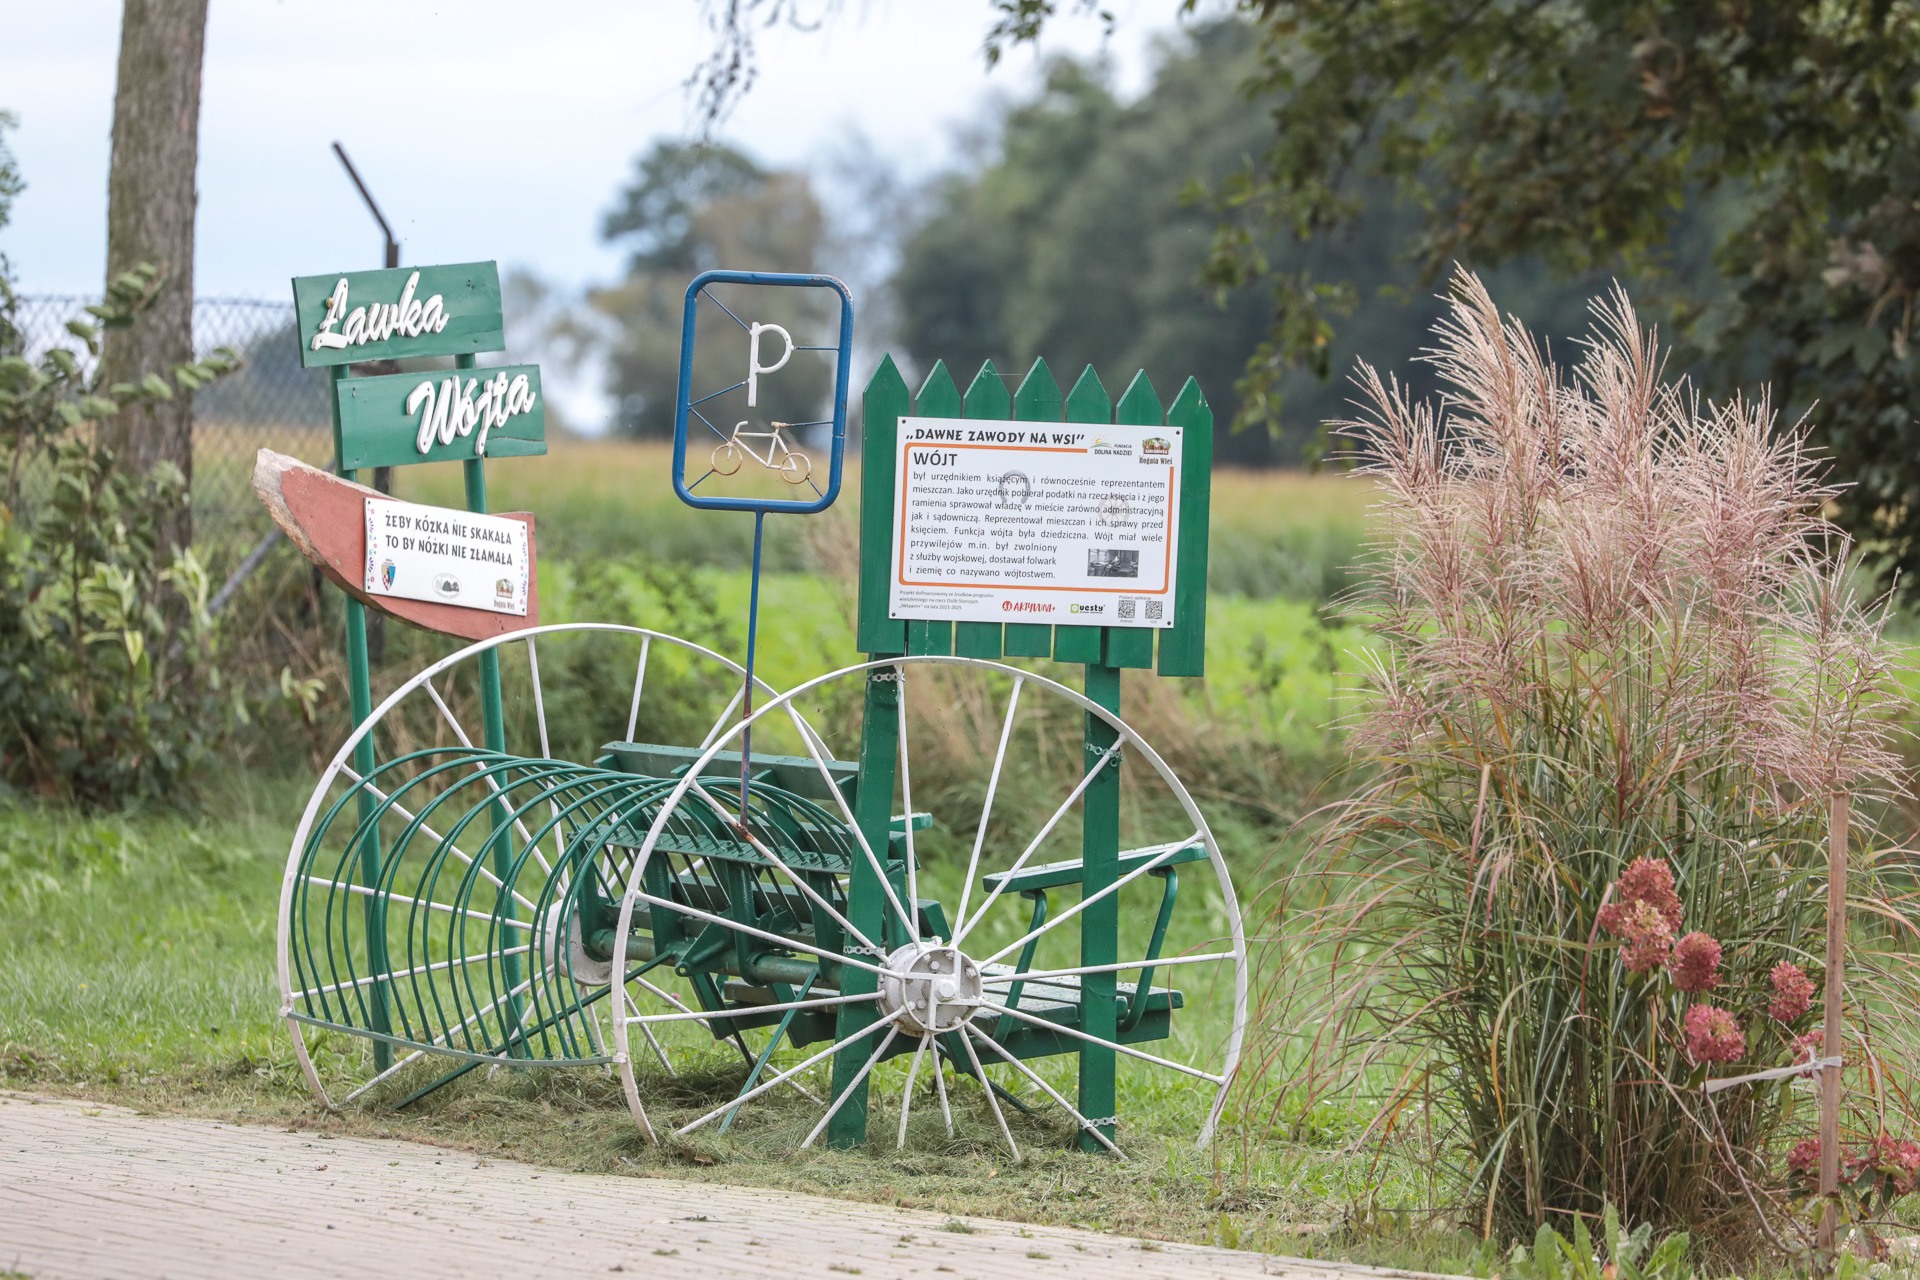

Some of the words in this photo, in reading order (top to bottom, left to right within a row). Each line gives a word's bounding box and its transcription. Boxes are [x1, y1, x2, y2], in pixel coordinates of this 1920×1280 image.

[310, 271, 450, 351] Ławka
[748, 321, 793, 407] P
[406, 371, 536, 455] Wójta
[968, 430, 1026, 442] ZAWODY
[1030, 432, 1048, 444] NA
[913, 450, 958, 466] WÓJT
[913, 471, 926, 480] był
[931, 472, 981, 482] urzędnikiem
[987, 474, 1028, 484] książęcym
[1032, 475, 1036, 484] i
[1041, 476, 1096, 486] równocześnie
[1101, 479, 1165, 489] reprezentantem
[912, 486, 955, 494] mieszczan.
[956, 486, 974, 495] Jako
[976, 486, 1009, 498] urzędnik
[1012, 488, 1044, 498] pobierał
[1046, 490, 1075, 500] podatki
[1110, 492, 1136, 502] księcia
[1148, 494, 1164, 504] jego
[912, 499, 946, 508] ramienia
[950, 500, 992, 510] sprawował
[994, 502, 1022, 512] władzę
[1034, 503, 1064, 512] mieście
[1067, 504, 1100, 513] zarówno
[1102, 506, 1164, 516] administracyjną
[386, 510, 411, 528] ŻEBY
[415, 515, 449, 535] KÓZKA
[470, 527, 512, 545] SKAKAŁA
[911, 512, 922, 521] jak
[926, 512, 930, 520] i
[933, 513, 980, 523] sądowniczą.
[984, 514, 1042, 524] Reprezentował
[1046, 518, 1086, 526] mieszczan
[1089, 518, 1092, 526] i
[1096, 518, 1106, 527] ich
[1110, 520, 1138, 529] sprawy
[1142, 520, 1163, 530] przed
[911, 525, 948, 535] księciem.
[954, 527, 984, 537] Funkcja
[990, 528, 1012, 538] wójta
[1018, 528, 1035, 539] była
[1040, 530, 1088, 540] dziedziczna.
[1094, 532, 1114, 542] Wójt
[1118, 533, 1136, 541] miał
[1142, 534, 1162, 542] wiele
[386, 535, 399, 548] TO
[402, 537, 415, 550] BY
[418, 536, 448, 556] NÓŻKI
[452, 545, 466, 559] NIE
[470, 548, 513, 566] ZŁAMAŁA
[910, 539, 962, 549] przywilejów
[968, 541, 990, 550] m.in.
[996, 542, 1008, 551] był
[1014, 543, 1057, 553] zwolniony
[916, 552, 941, 562] służby
[943, 554, 987, 564] wojskowej,
[989, 554, 1025, 564] dostawał
[1027, 556, 1056, 565] folwark
[916, 566, 942, 576] ziemię
[960, 569, 1000, 578] nazywano
[1004, 569, 1056, 579] wójtostwem.
